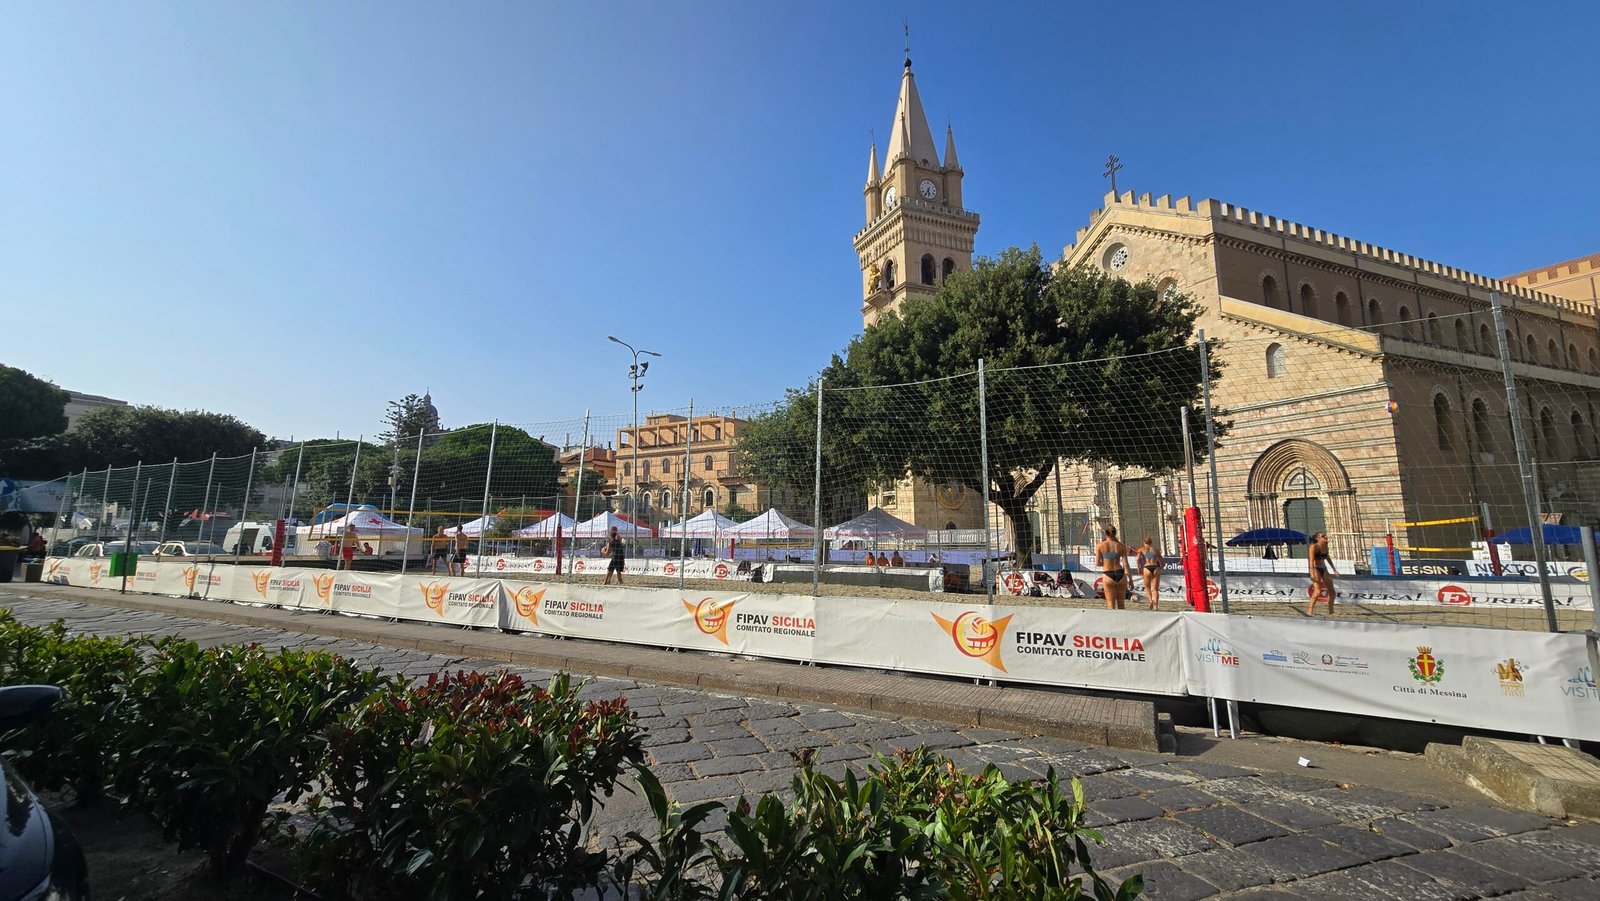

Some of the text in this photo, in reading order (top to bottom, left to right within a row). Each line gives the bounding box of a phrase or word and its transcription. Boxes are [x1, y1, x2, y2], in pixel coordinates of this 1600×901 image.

[1402, 565, 1449, 574] ESSIN
[352, 585, 372, 593] SICILIA
[449, 593, 494, 603] FIPAV SICILIA
[545, 600, 604, 612] FIPAV SICILIA
[737, 613, 815, 629] FIPAV SICILIA
[736, 624, 816, 637] COMITATO REGIONALE
[1016, 632, 1145, 651] FIPAV SICILIA
[1017, 646, 1146, 661] COMITATO REGIONALE
[1393, 685, 1415, 693] Città
[1430, 689, 1467, 698] Messina
